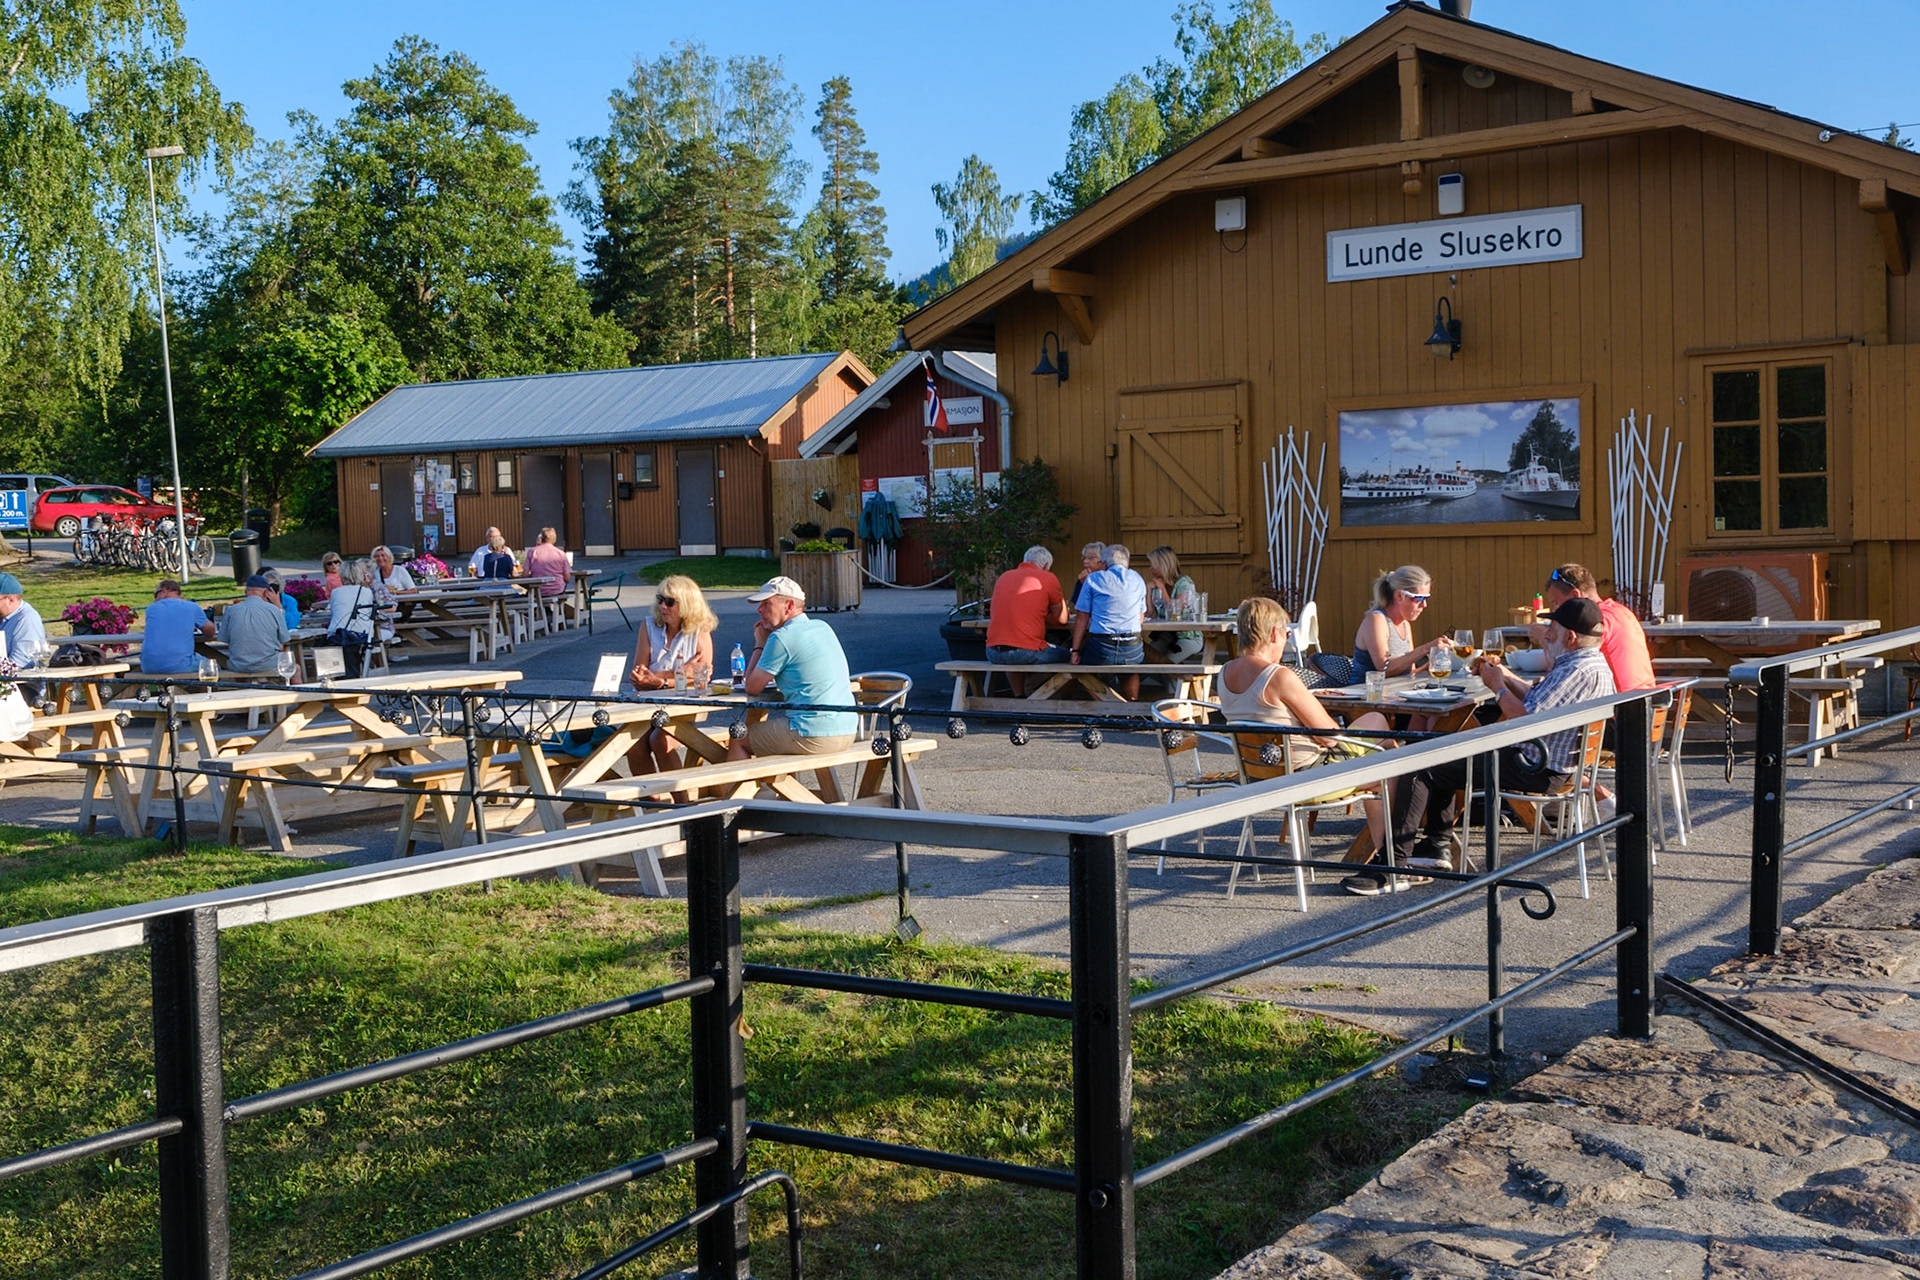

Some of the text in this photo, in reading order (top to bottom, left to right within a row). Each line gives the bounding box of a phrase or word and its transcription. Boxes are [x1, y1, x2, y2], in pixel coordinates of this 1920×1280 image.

[1345, 225, 1562, 268] Lunde Slusekro
[946, 405, 980, 417] RMASJON
